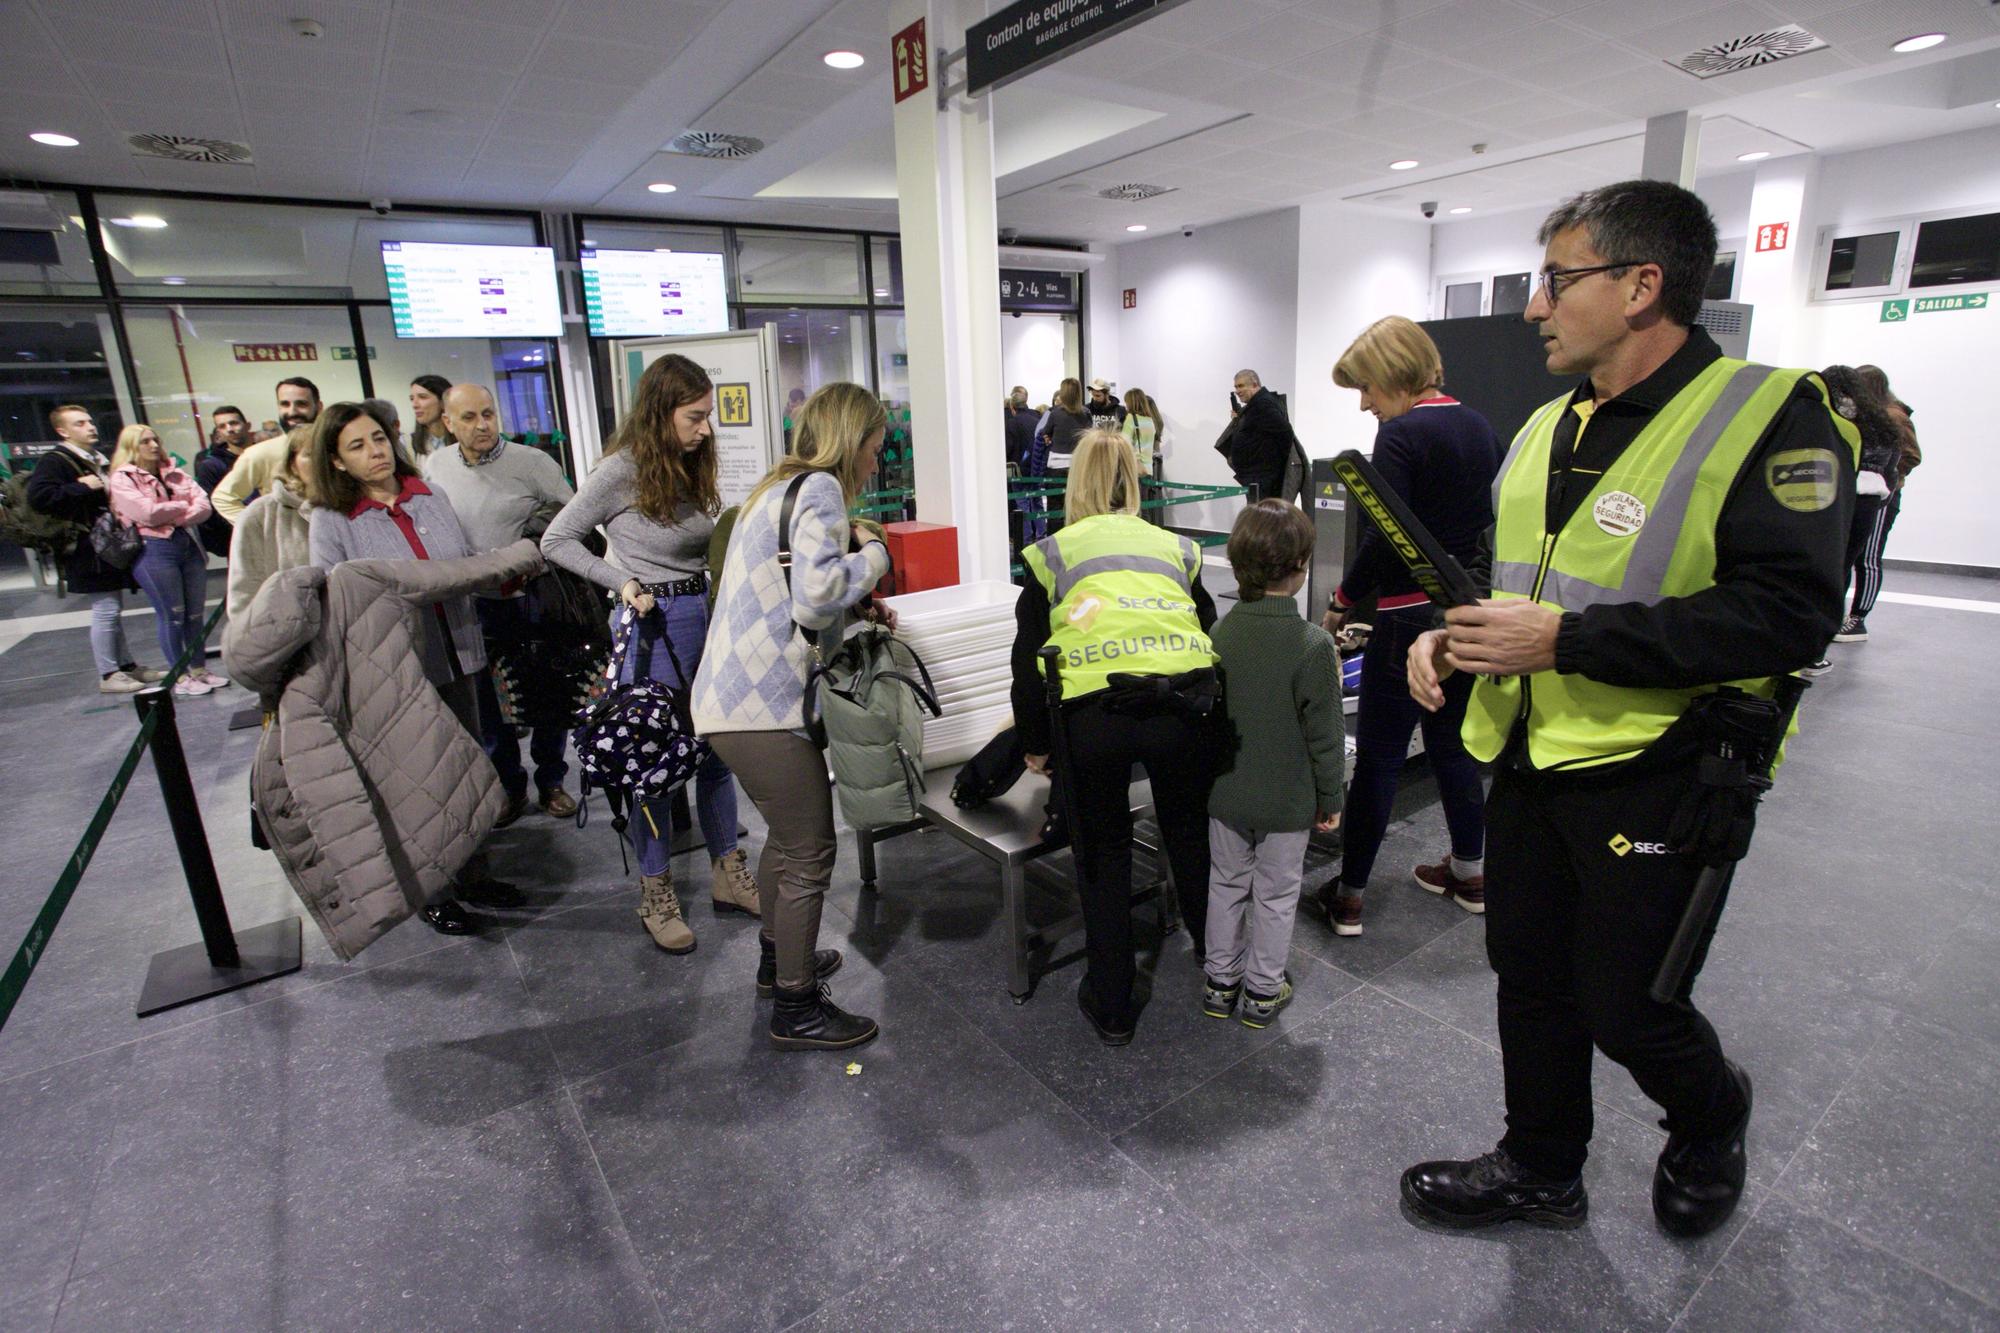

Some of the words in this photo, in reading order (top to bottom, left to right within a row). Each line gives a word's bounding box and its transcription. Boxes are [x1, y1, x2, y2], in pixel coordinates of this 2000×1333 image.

[987, 17, 1024, 52] Control
[1026, 11, 1041, 32] de
[1043, 0, 1089, 23] equip
[1035, 21, 1069, 46] BAGGAGE
[1070, 4, 1105, 29] CONTROL
[1918, 297, 1963, 311] SALIDA
[1342, 469, 1419, 560] GARRETT
[1595, 505, 1642, 528] SEGURIDAD
[1602, 493, 1643, 518] VIGILANTE
[1615, 503, 1627, 513] DE
